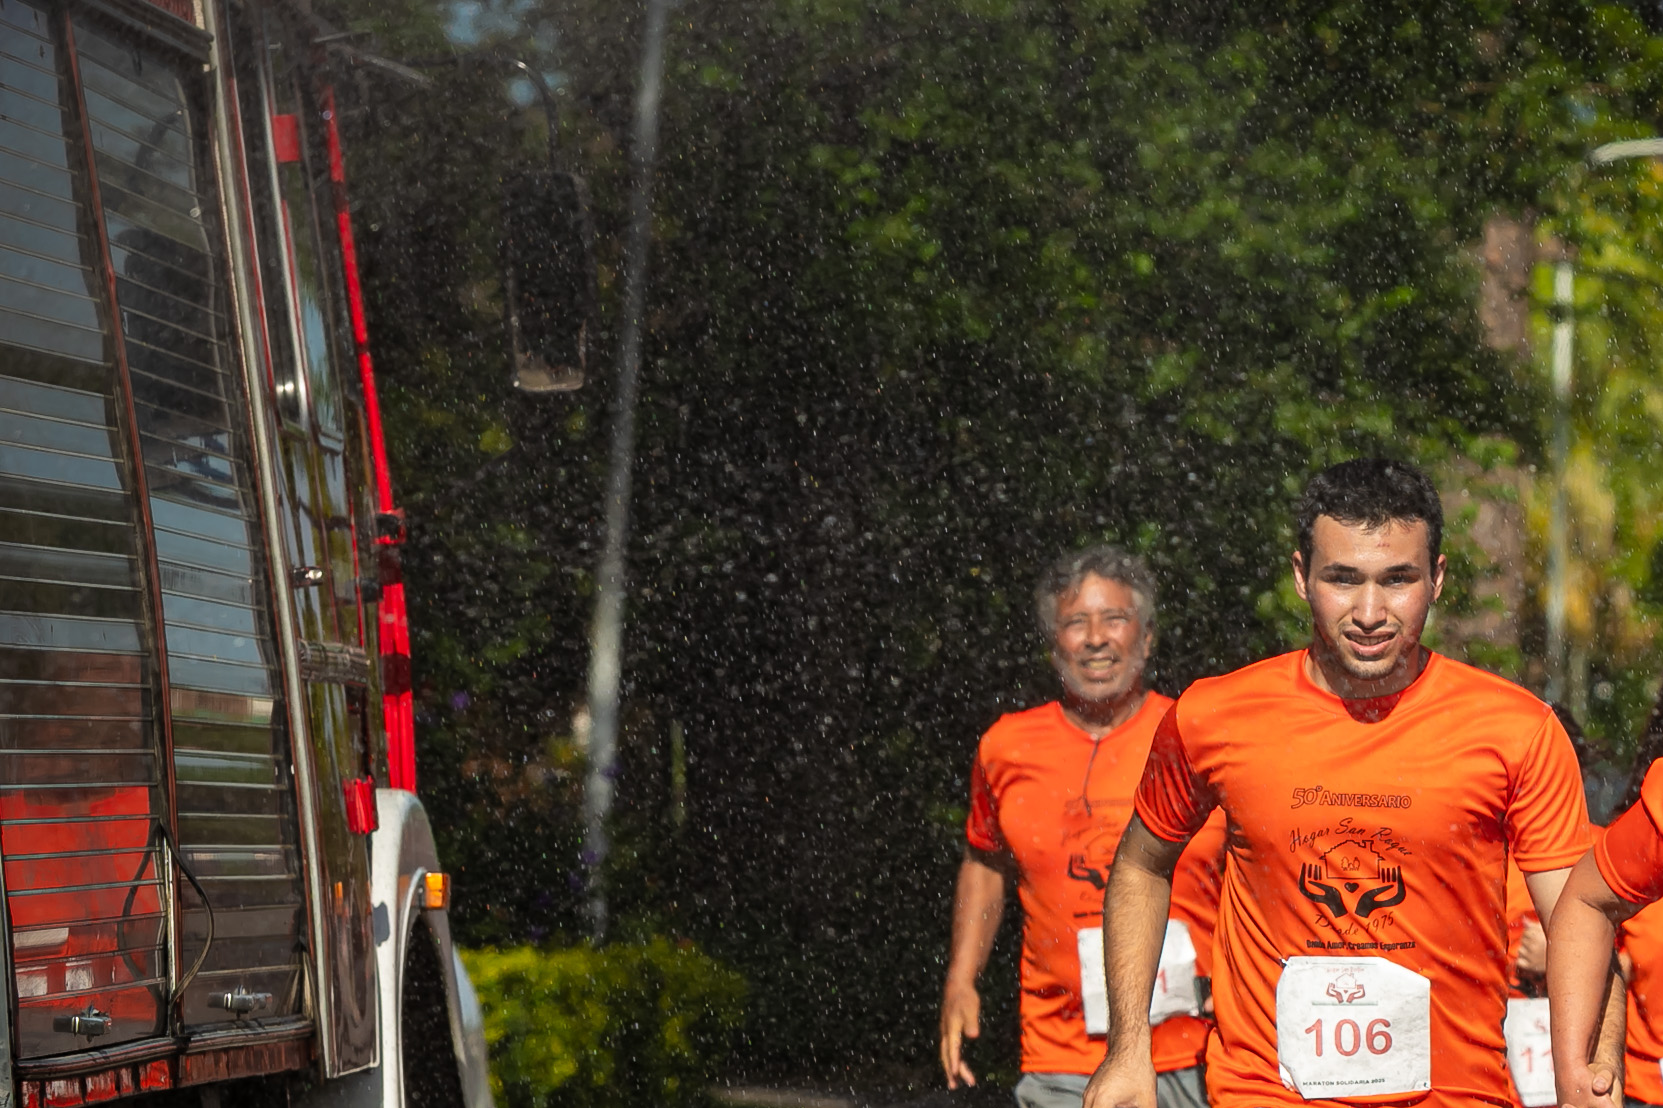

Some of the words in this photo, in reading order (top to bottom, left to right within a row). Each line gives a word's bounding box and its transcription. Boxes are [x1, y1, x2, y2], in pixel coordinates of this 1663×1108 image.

[1319, 790, 1412, 809] ANIVERSARIO
[1290, 827, 1330, 853] Hogar
[1334, 817, 1365, 835] San
[1315, 914, 1359, 936] Dsde
[1365, 911, 1395, 934] 1975
[1305, 1018, 1393, 1057] 106
